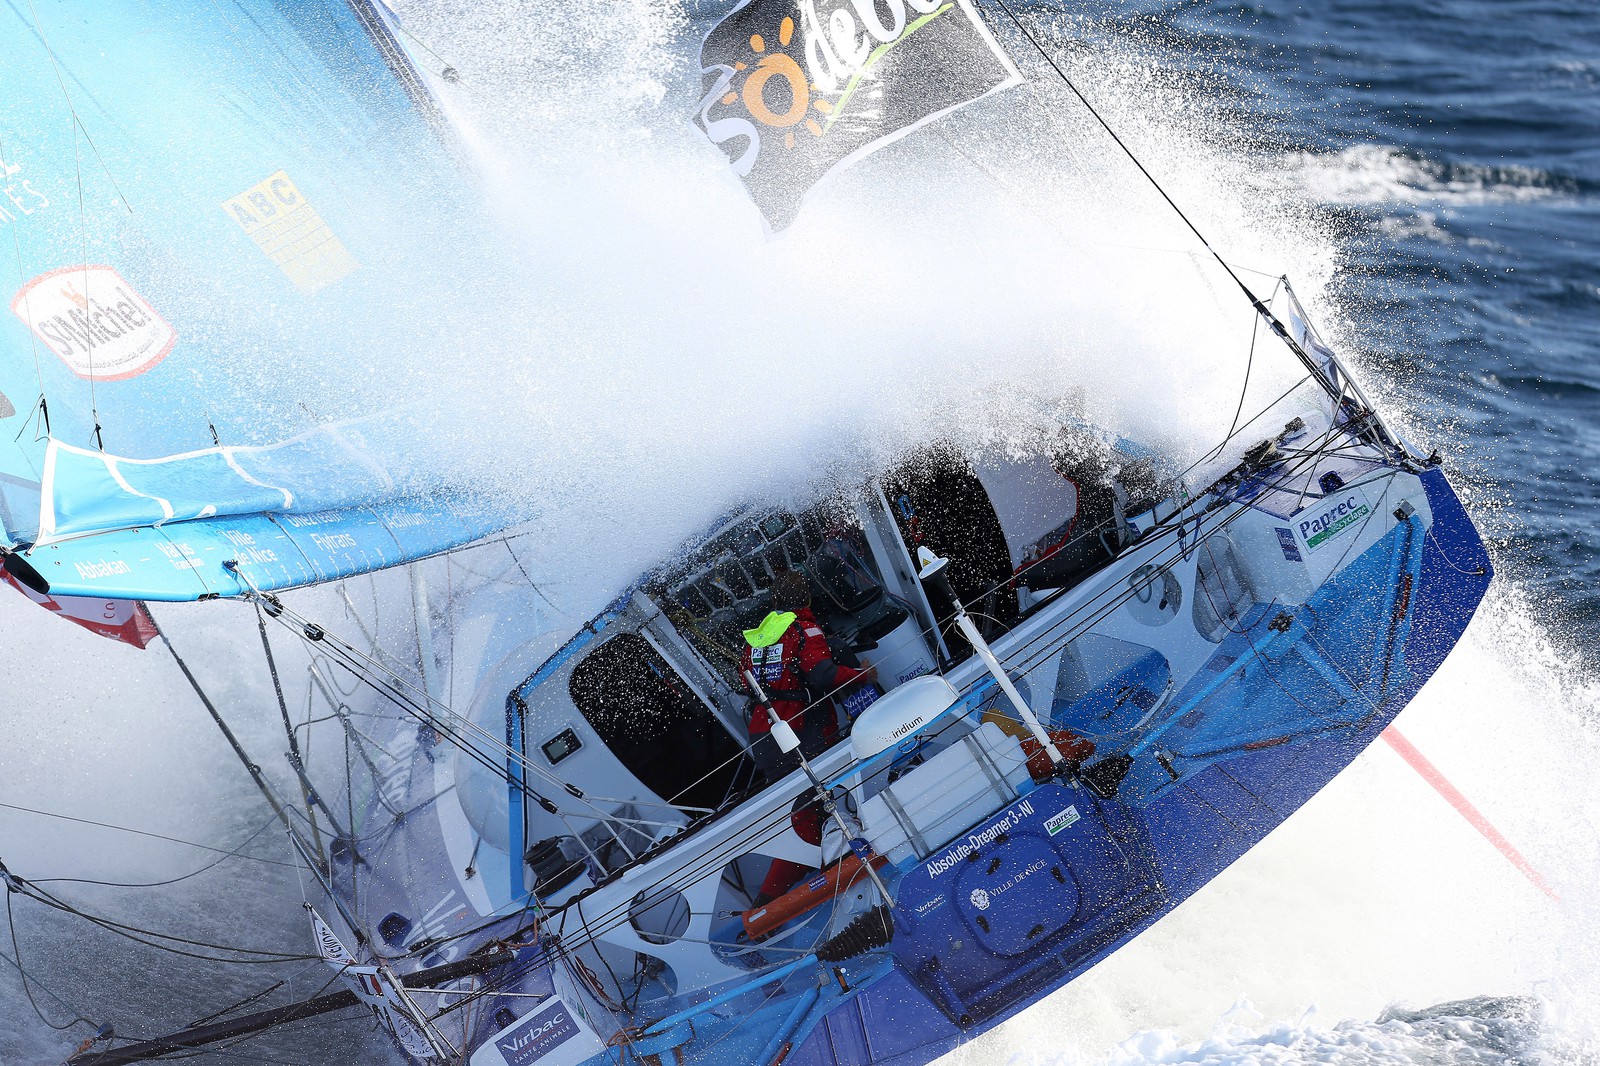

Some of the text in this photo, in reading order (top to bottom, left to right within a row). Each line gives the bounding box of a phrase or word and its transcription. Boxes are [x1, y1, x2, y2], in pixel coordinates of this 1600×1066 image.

[691, 0, 945, 178] Sodeb
[231, 178, 298, 230] ABC
[1299, 496, 1358, 540] Paprec
[222, 531, 257, 548] Ville
[310, 531, 357, 555] Flytrans
[233, 547, 279, 567] de Nice
[73, 558, 132, 581] Abbakan
[751, 647, 780, 658] Parec
[899, 663, 925, 685] Paprec
[892, 715, 924, 739] iridium
[1046, 809, 1073, 830] Paprec
[926, 816, 1012, 879] Absolute-Dreamer
[989, 859, 1048, 897] VILLE DE NICE
[914, 893, 945, 913] Virbac
[503, 1012, 566, 1052] Virbac
